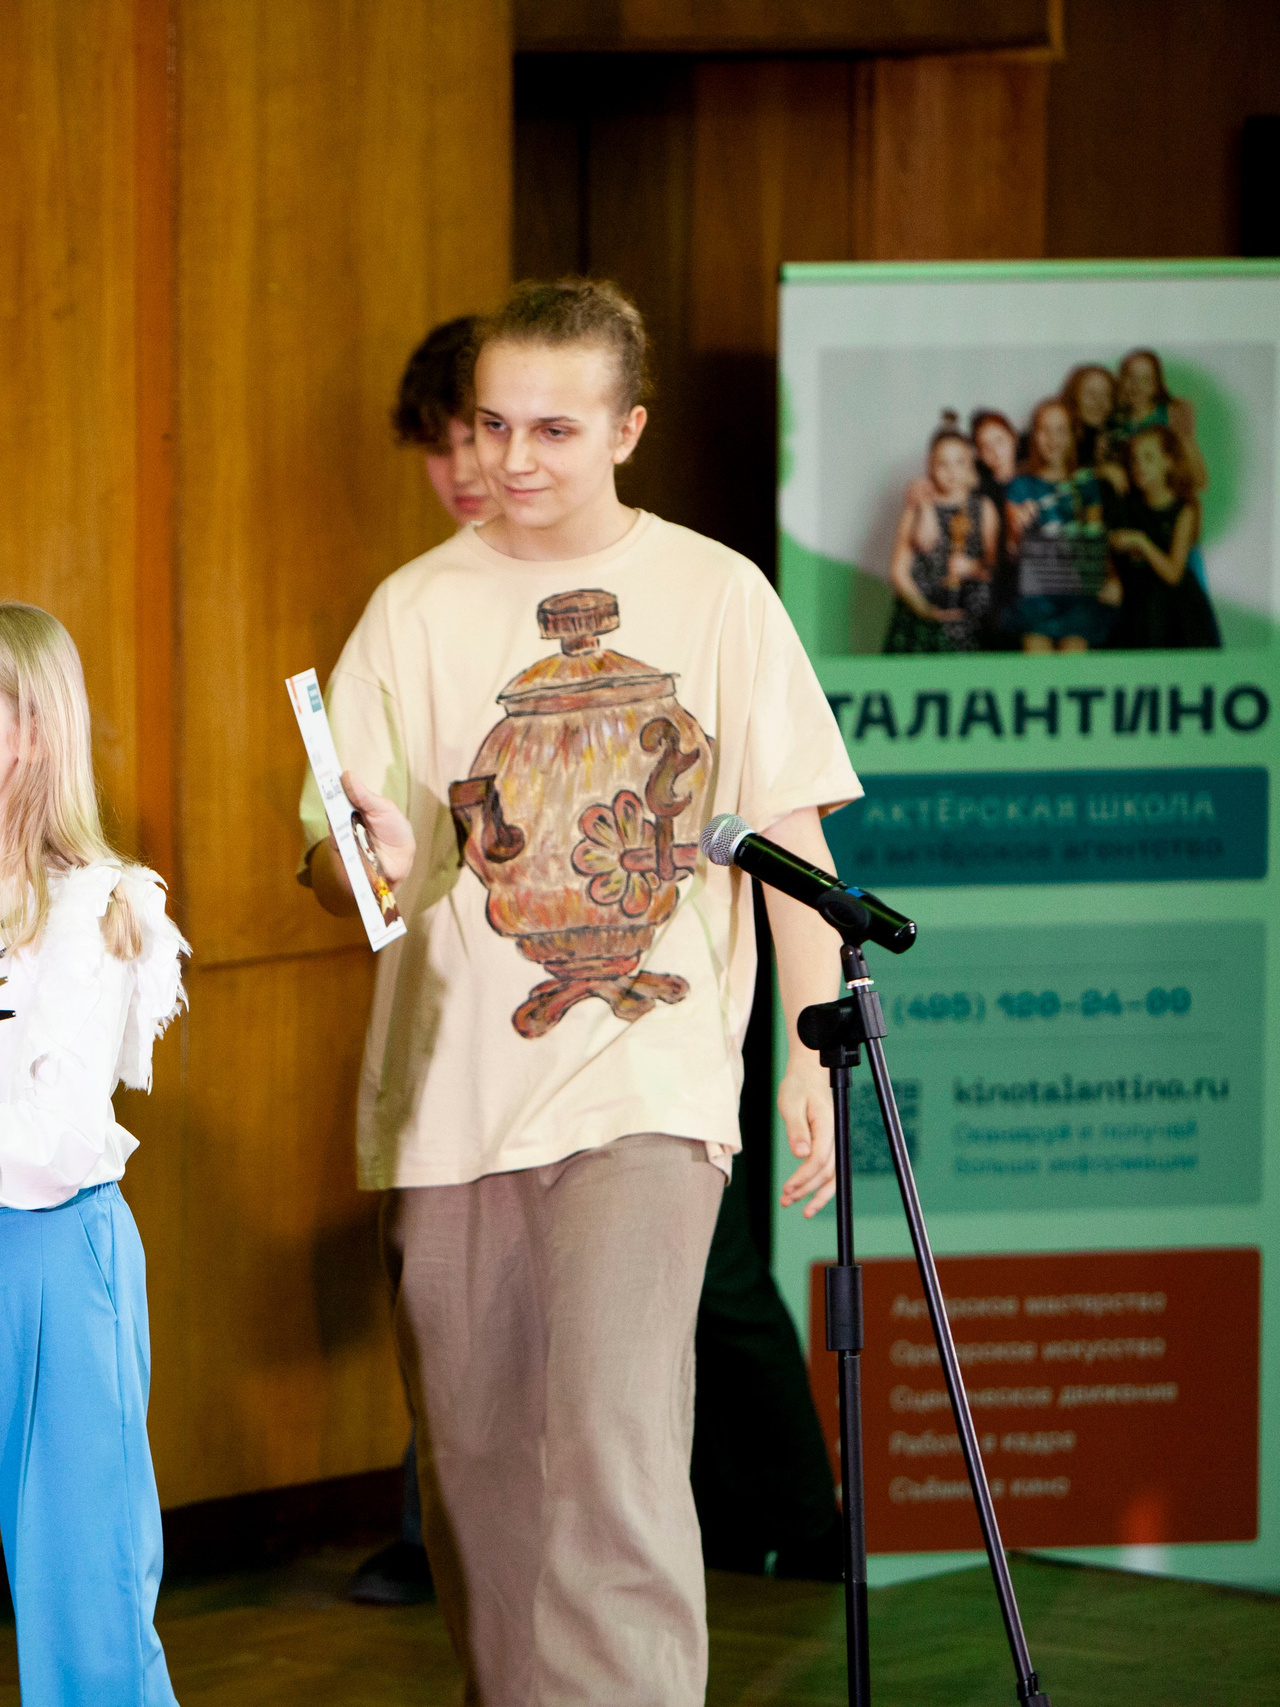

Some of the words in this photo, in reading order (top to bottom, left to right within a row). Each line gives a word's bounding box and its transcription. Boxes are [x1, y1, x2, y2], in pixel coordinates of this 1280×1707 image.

[823, 683, 1270, 741] ТАЛАНТИНО
[861, 789, 1077, 827] АКТЁРСКАЯ
[1087, 789, 1216, 825] ШКОЛА
[952, 1072, 1230, 1106] kinotalantino.ru
